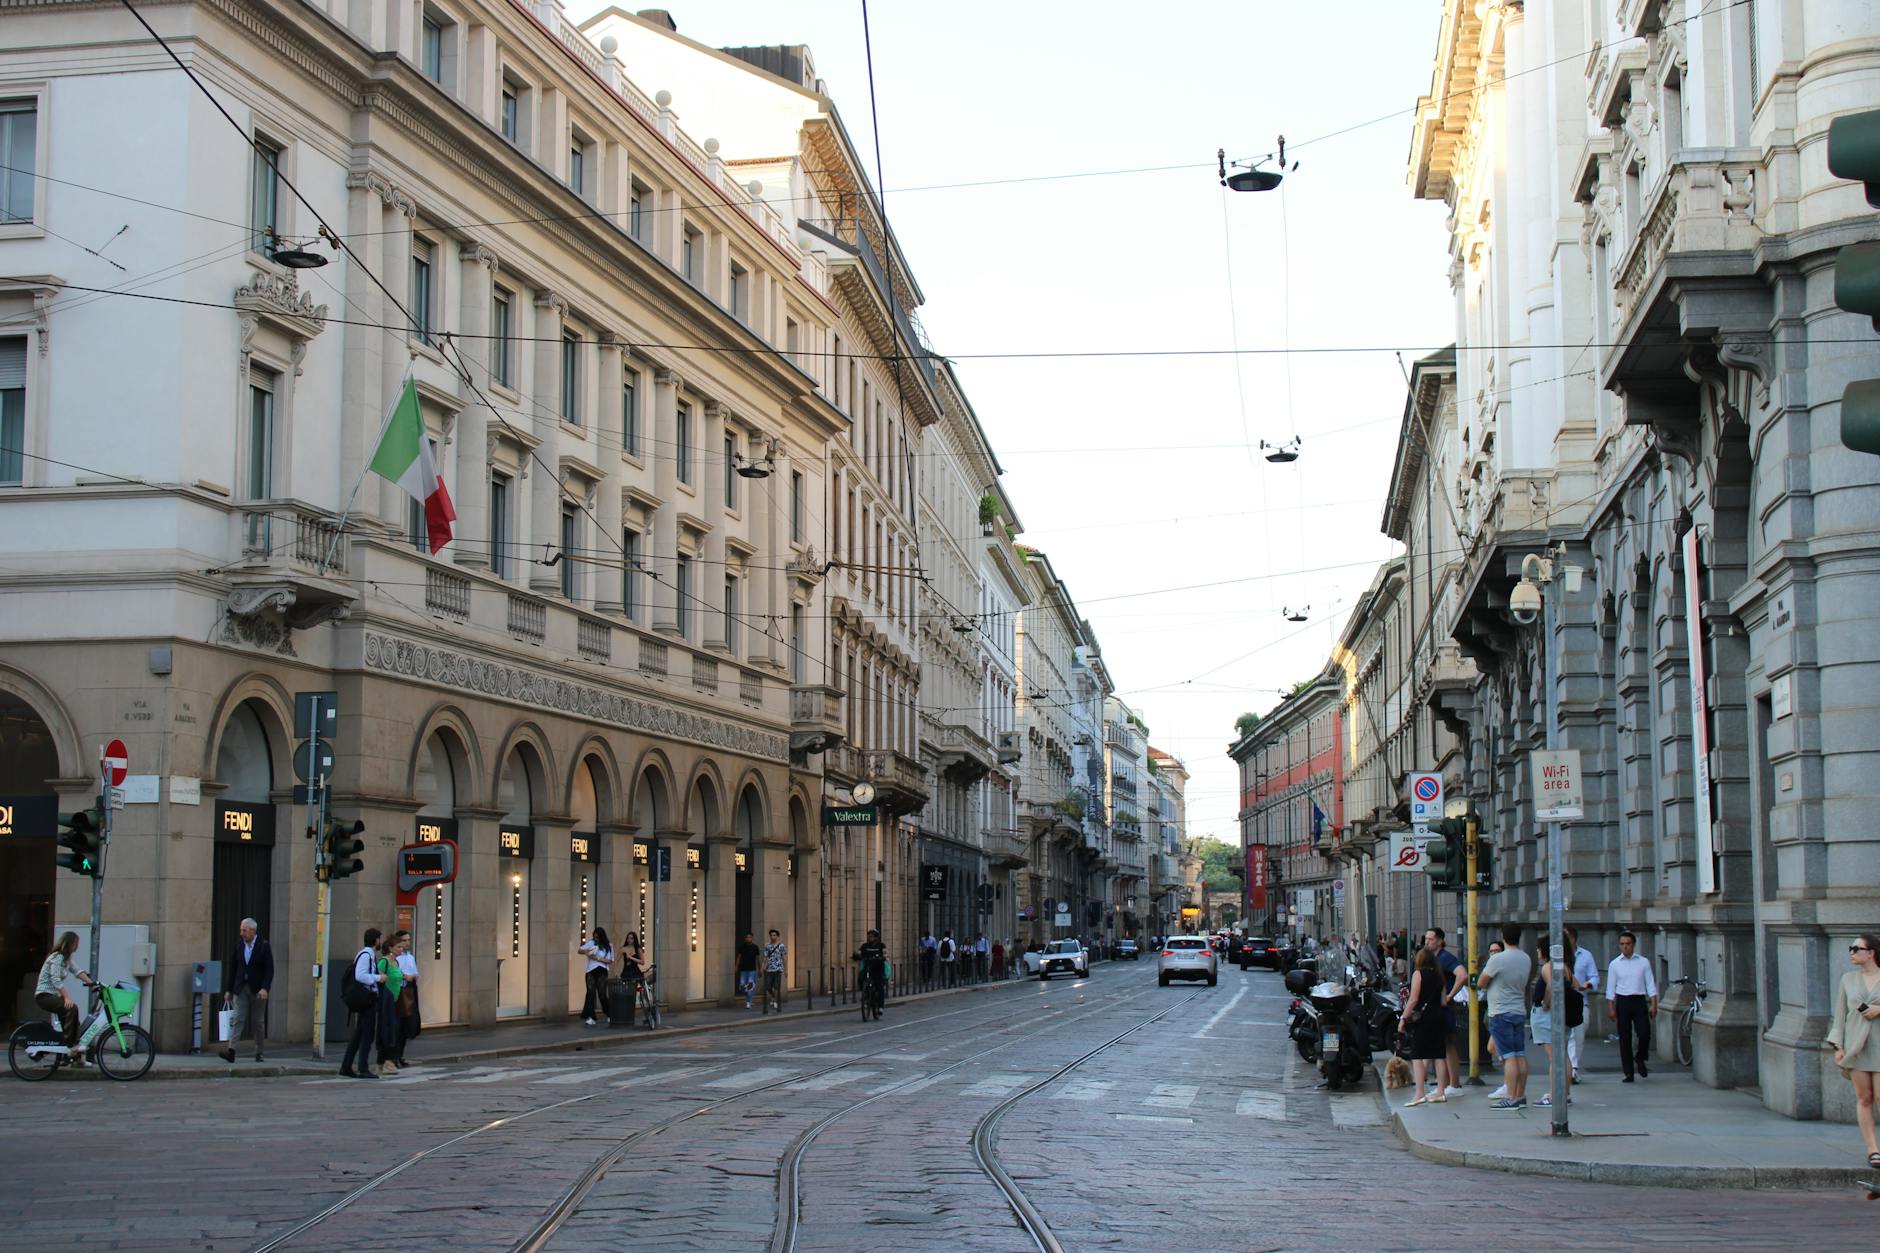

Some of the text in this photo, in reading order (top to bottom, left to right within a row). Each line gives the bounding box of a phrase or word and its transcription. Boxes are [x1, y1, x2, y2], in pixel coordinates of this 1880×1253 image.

[1543, 765, 1569, 778] Wi-Fi
[1544, 779, 1570, 790] area
[224, 811, 252, 831] FENDI
[834, 811, 871, 821] Valextra
[420, 825, 440, 842] FENDI
[502, 832, 520, 849] FENDI
[572, 838, 588, 854] FENDI
[633, 843, 648, 858] FENDI
